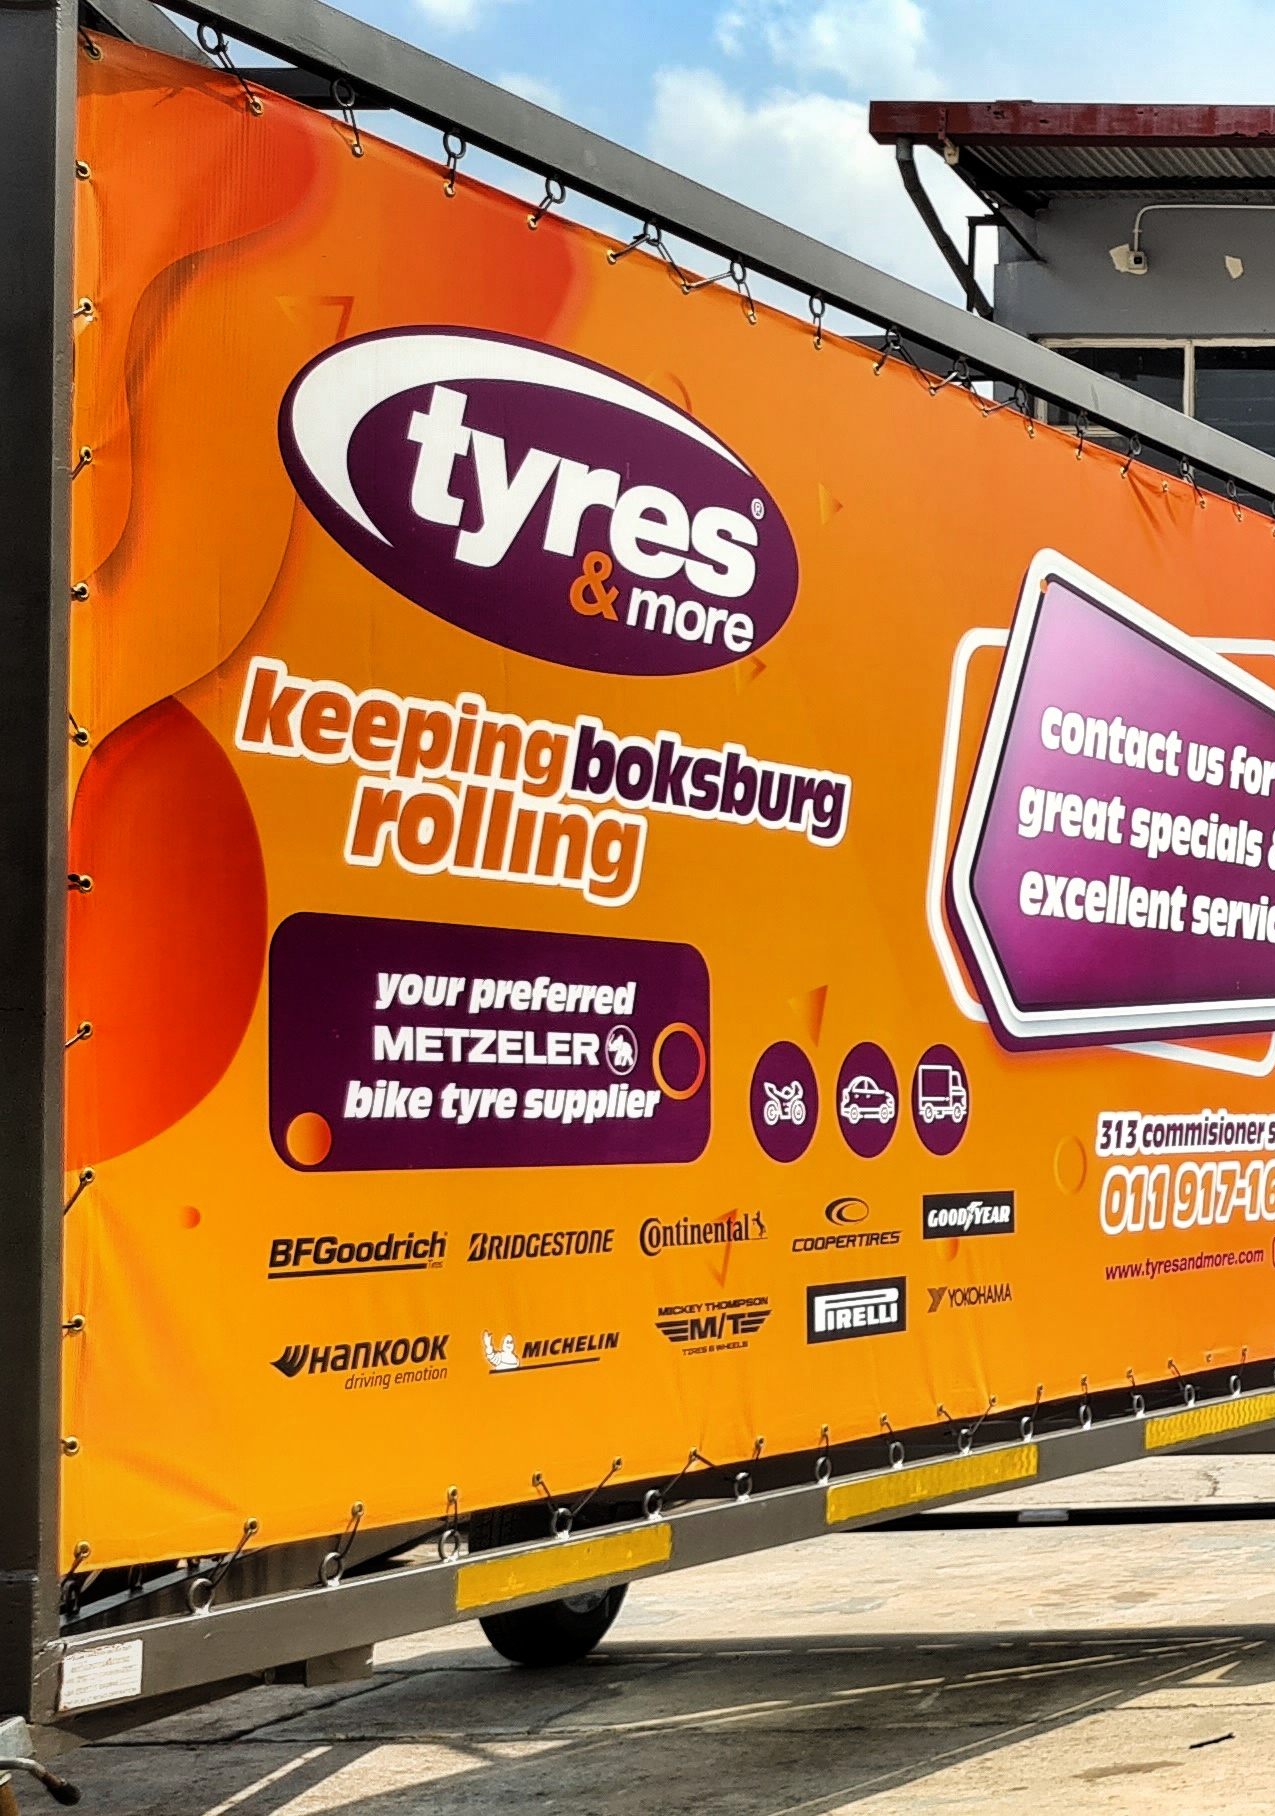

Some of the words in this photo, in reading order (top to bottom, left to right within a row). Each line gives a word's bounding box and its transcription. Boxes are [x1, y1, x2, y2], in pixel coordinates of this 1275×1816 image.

[407, 384, 761, 600] tyres
[569, 550, 620, 622] &
[626, 586, 756, 654] more
[238, 662, 570, 800] keeping
[571, 724, 847, 840] boksburg
[1041, 705, 1181, 778] contact
[1186, 741, 1224, 782] us
[348, 782, 644, 902] rolling
[1017, 783, 1124, 844] great
[1129, 807, 1263, 871] specials
[1018, 870, 1187, 934] excellent
[375, 972, 466, 1014] your
[468, 972, 637, 1016] preferred
[373, 1026, 600, 1067] METZELER
[343, 1080, 432, 1122] bike
[439, 1083, 518, 1126] tyre
[522, 1080, 661, 1126] supplier
[1099, 1118, 1139, 1150] 313
[1141, 1116, 1266, 1148] commisioner
[1101, 1167, 1169, 1233] 011
[268, 1232, 447, 1268] BFGoodrich
[467, 1229, 616, 1262] BRIDGESTONE
[639, 1212, 750, 1257] Continental
[1105, 1248, 1264, 1281] www.tyresandmore.com
[658, 1303, 703, 1316] MICKEY
[705, 1296, 768, 1312] THOMPSON
[814, 1286, 900, 1333] PIRELLI
[948, 1283, 1012, 1308] YOKOHAMA
[522, 1332, 620, 1359] MICHELIN
[344, 1372, 391, 1392] driving
[394, 1365, 448, 1386] emotion
